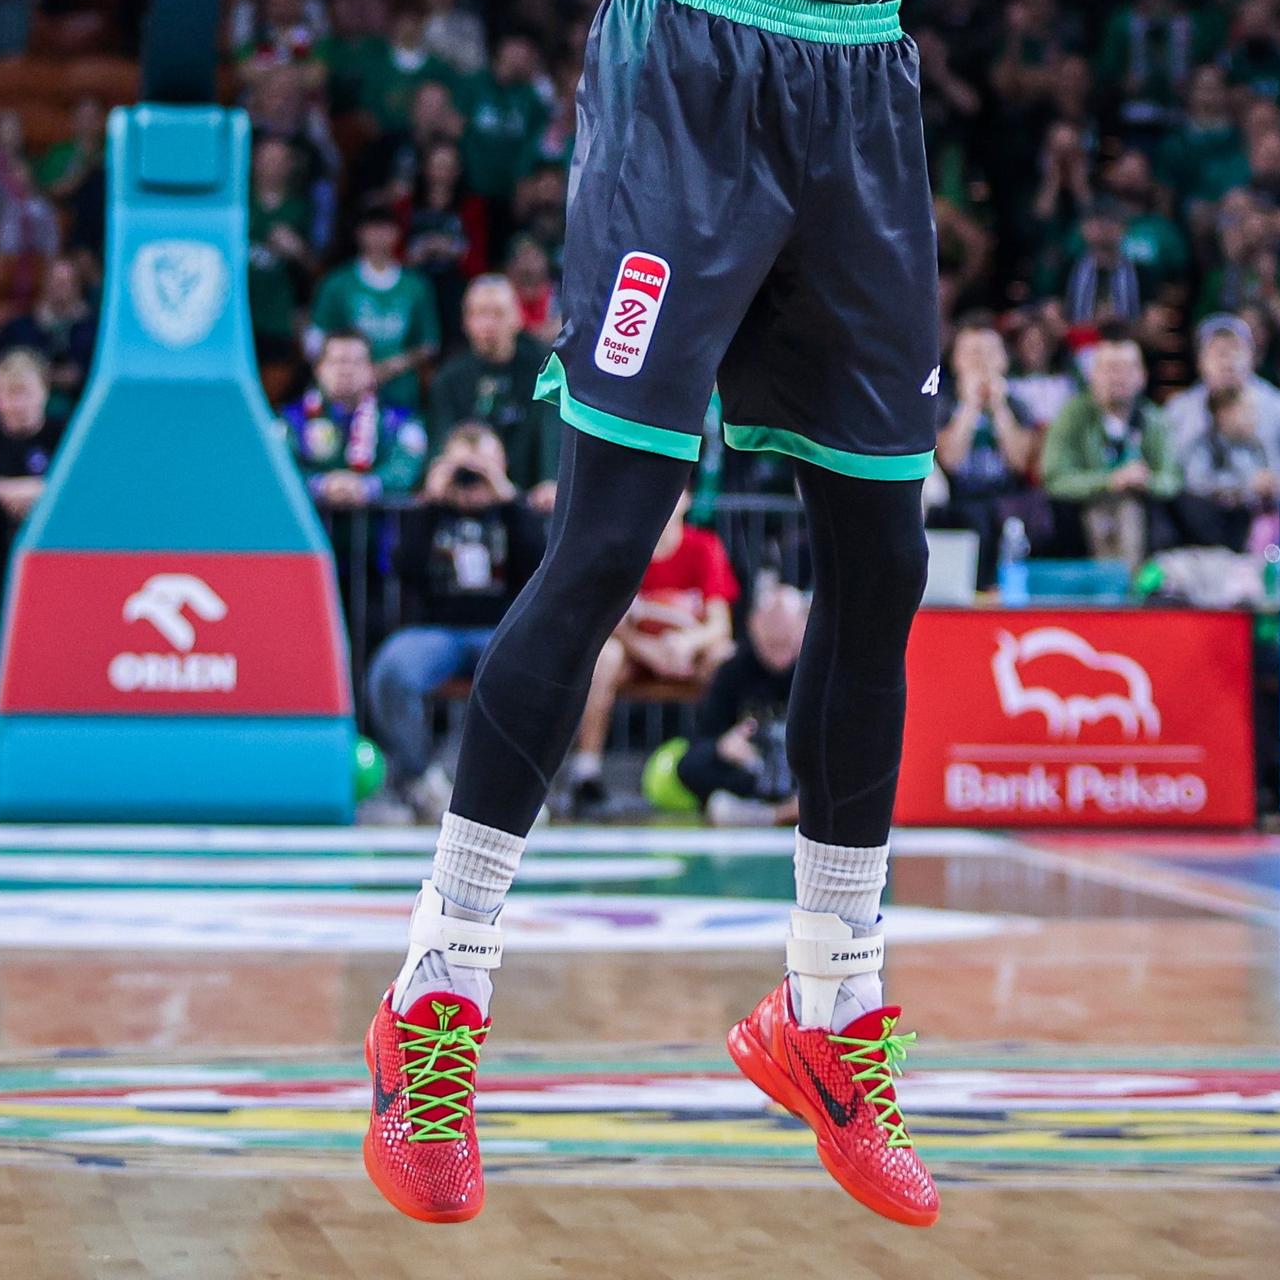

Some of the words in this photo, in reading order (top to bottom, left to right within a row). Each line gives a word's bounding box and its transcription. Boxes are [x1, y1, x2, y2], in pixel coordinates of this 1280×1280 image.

[623, 268, 664, 287] ORLEN
[603, 337, 640, 357] Basket
[606, 350, 629, 366] Liga
[108, 652, 237, 692] ORLEN
[945, 763, 1062, 810] Bank
[1067, 763, 1208, 813] Pekao
